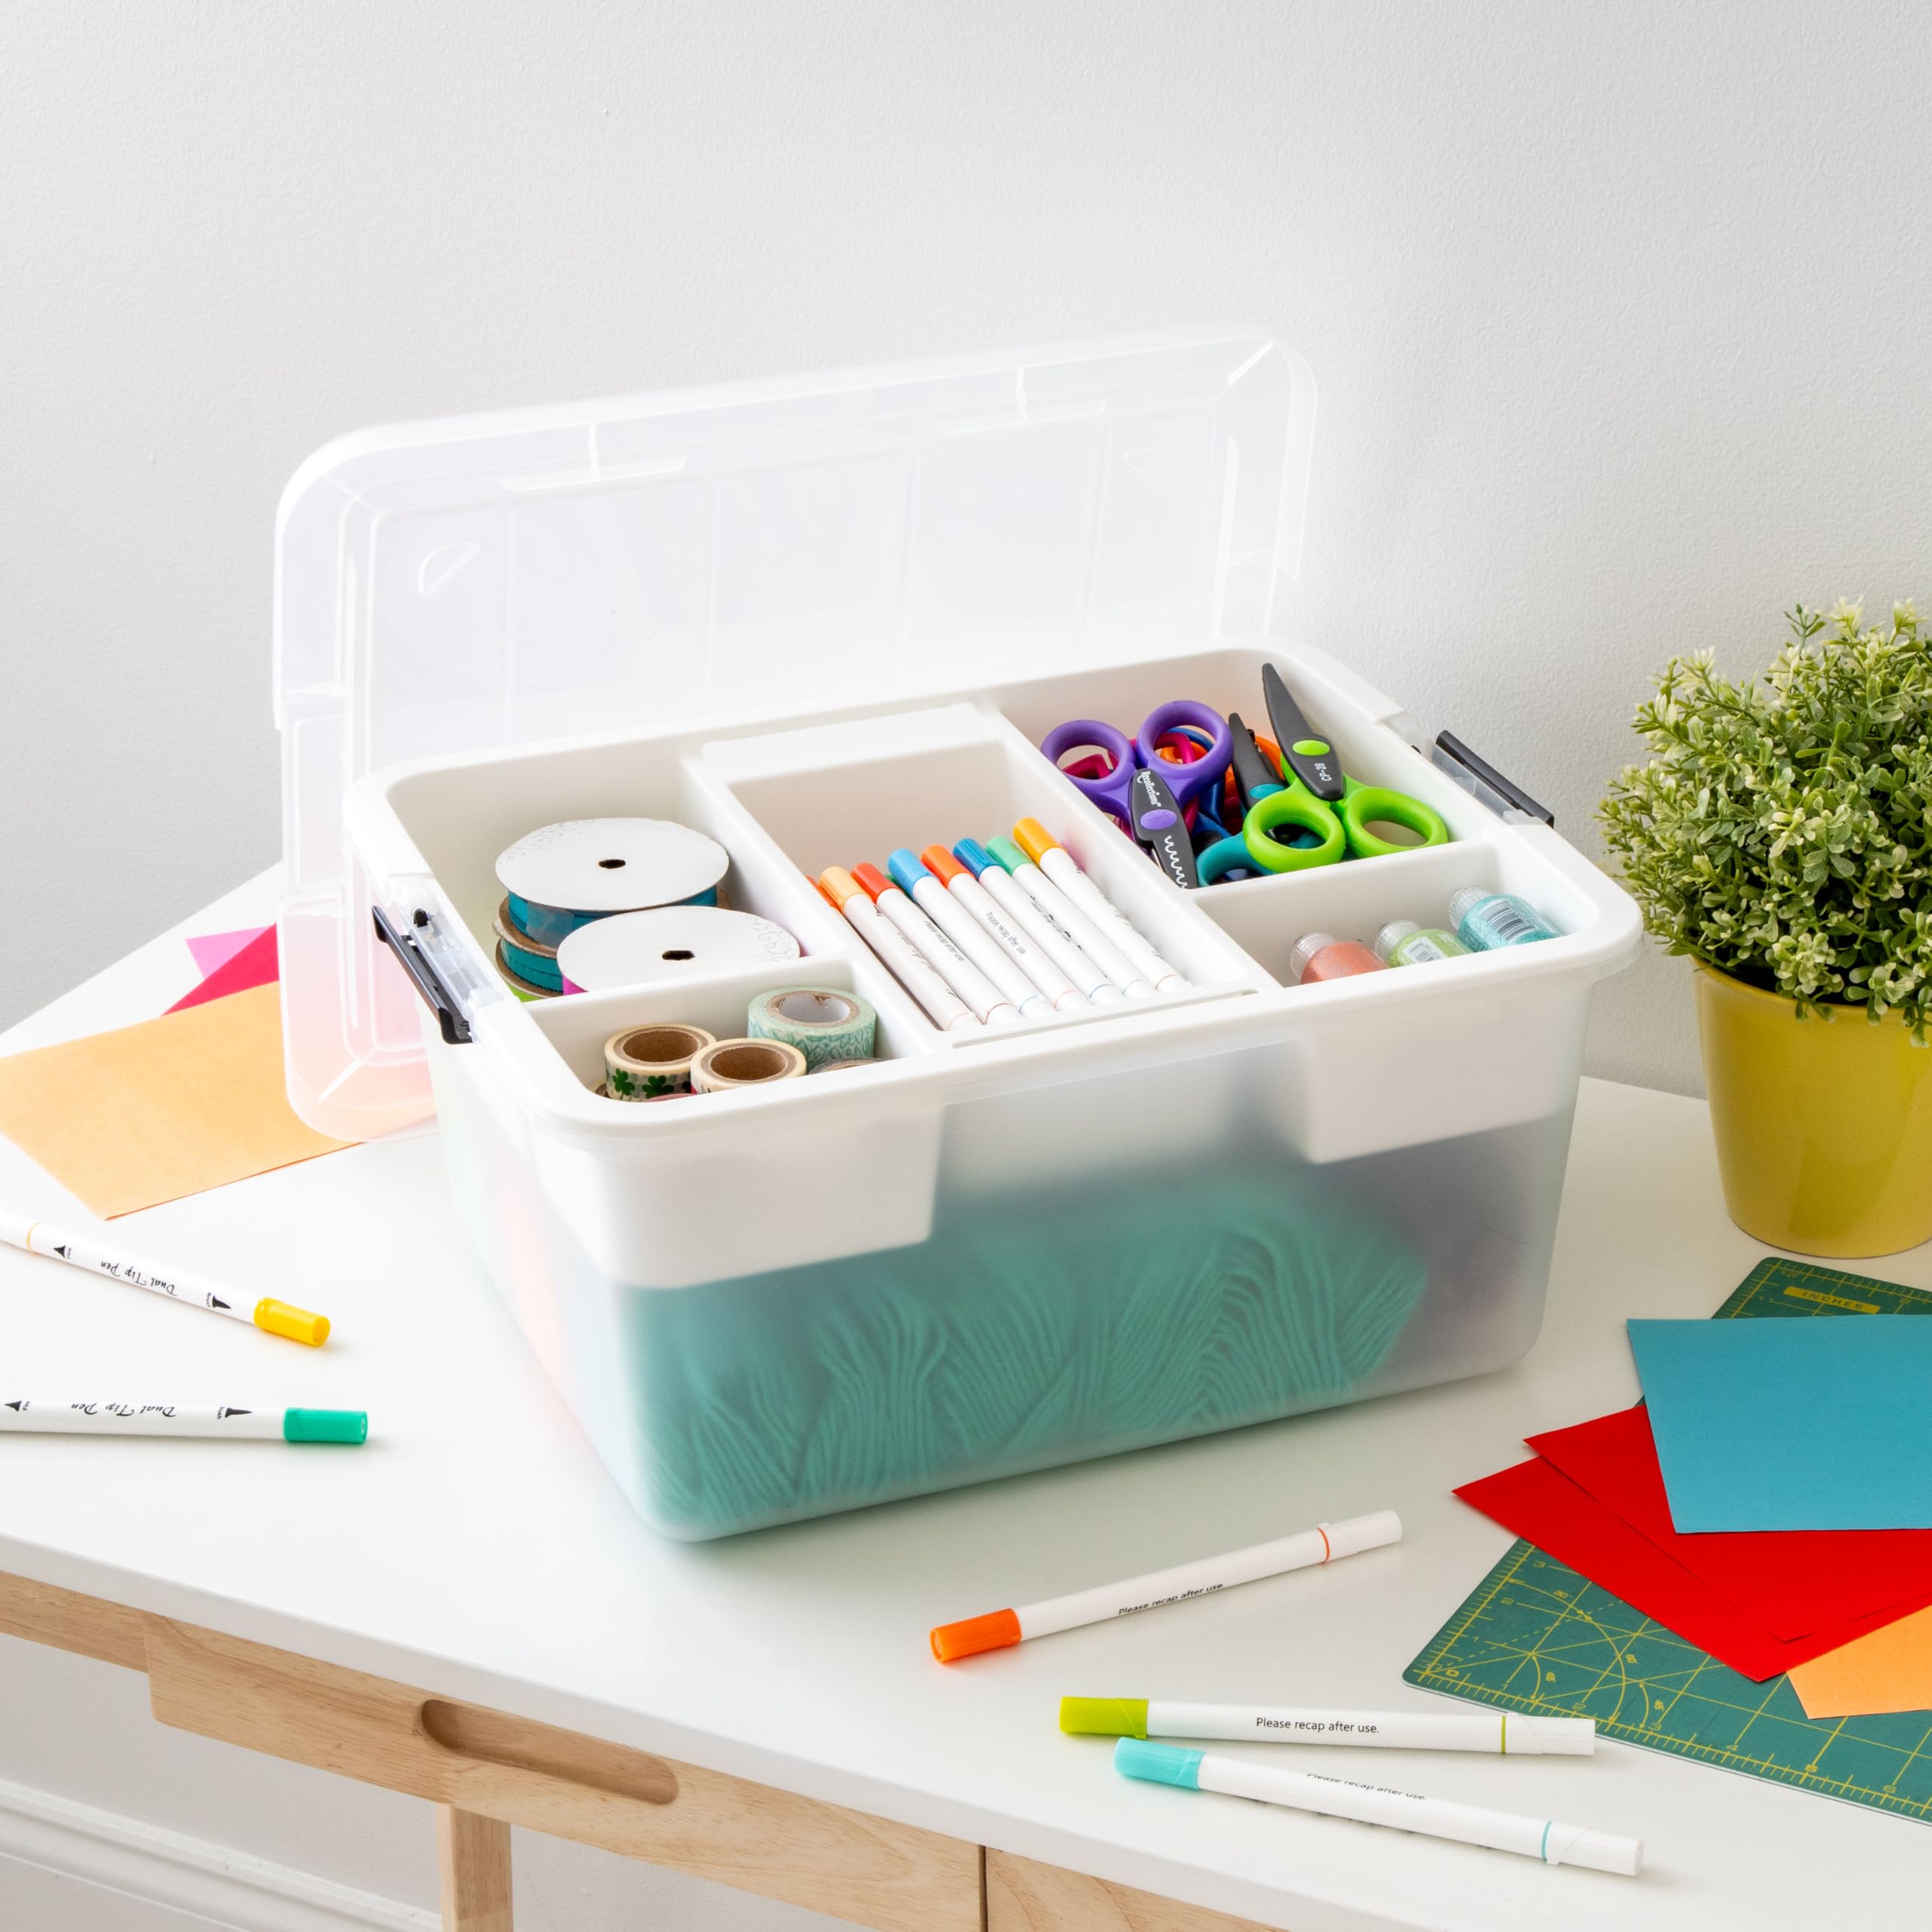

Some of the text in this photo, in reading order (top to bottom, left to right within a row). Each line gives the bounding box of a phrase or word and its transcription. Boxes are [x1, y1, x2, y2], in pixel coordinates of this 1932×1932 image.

[985, 911, 999, 928] Please
[997, 924, 1010, 938] recap
[1008, 936, 1018, 946] after
[100, 1260, 177, 1296] Dual Tip Pen
[71, 1402, 177, 1417] Dual Tip Pen
[1118, 1603, 1149, 1615] Please
[1152, 1595, 1178, 1606] recap
[1181, 1587, 1204, 1598] after
[1256, 1717, 1380, 1734] Please recap after use.
[1307, 1773, 1342, 1783] Please
[1344, 1780, 1374, 1790] recap
[1377, 1787, 1404, 1795] after
